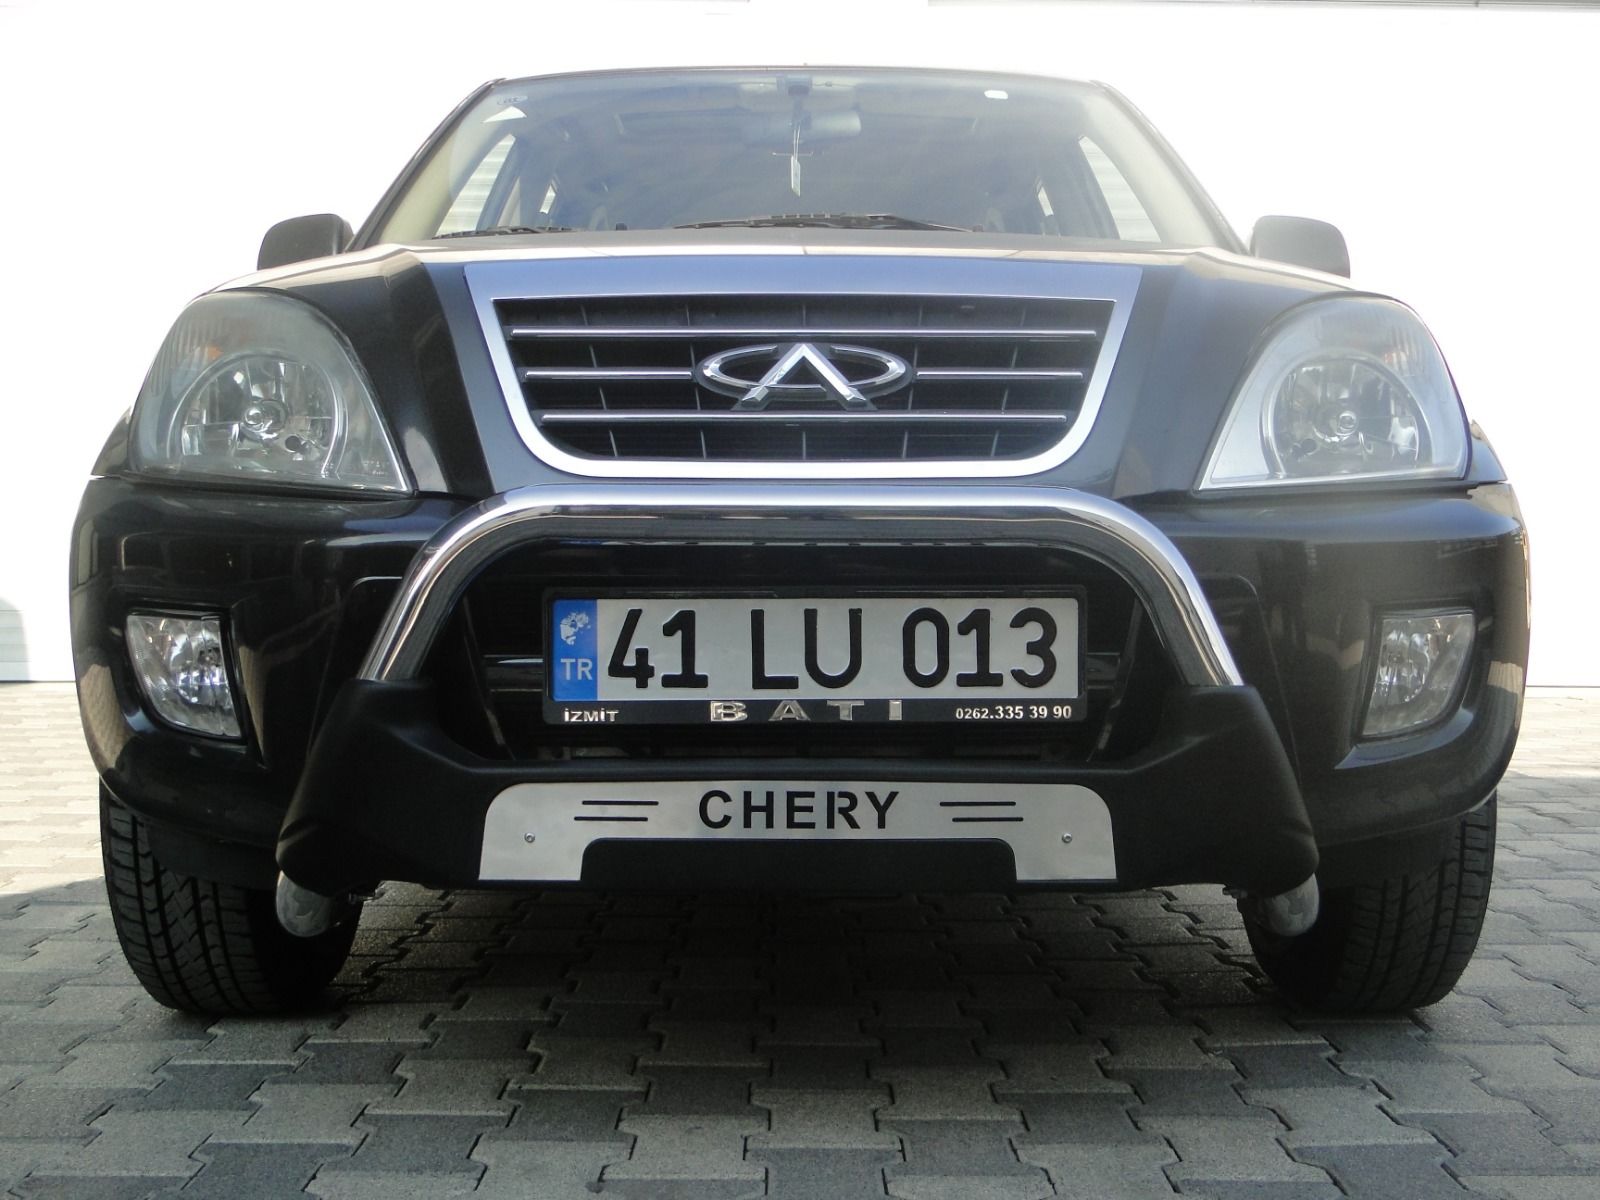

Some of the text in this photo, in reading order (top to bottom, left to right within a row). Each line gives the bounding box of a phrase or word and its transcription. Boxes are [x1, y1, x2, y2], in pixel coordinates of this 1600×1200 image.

[608, 607, 1058, 690] 41 LU 013
[560, 658, 593, 681] TR
[955, 705, 1072, 720] 0262.335 39 90
[699, 789, 900, 829] CHERY
